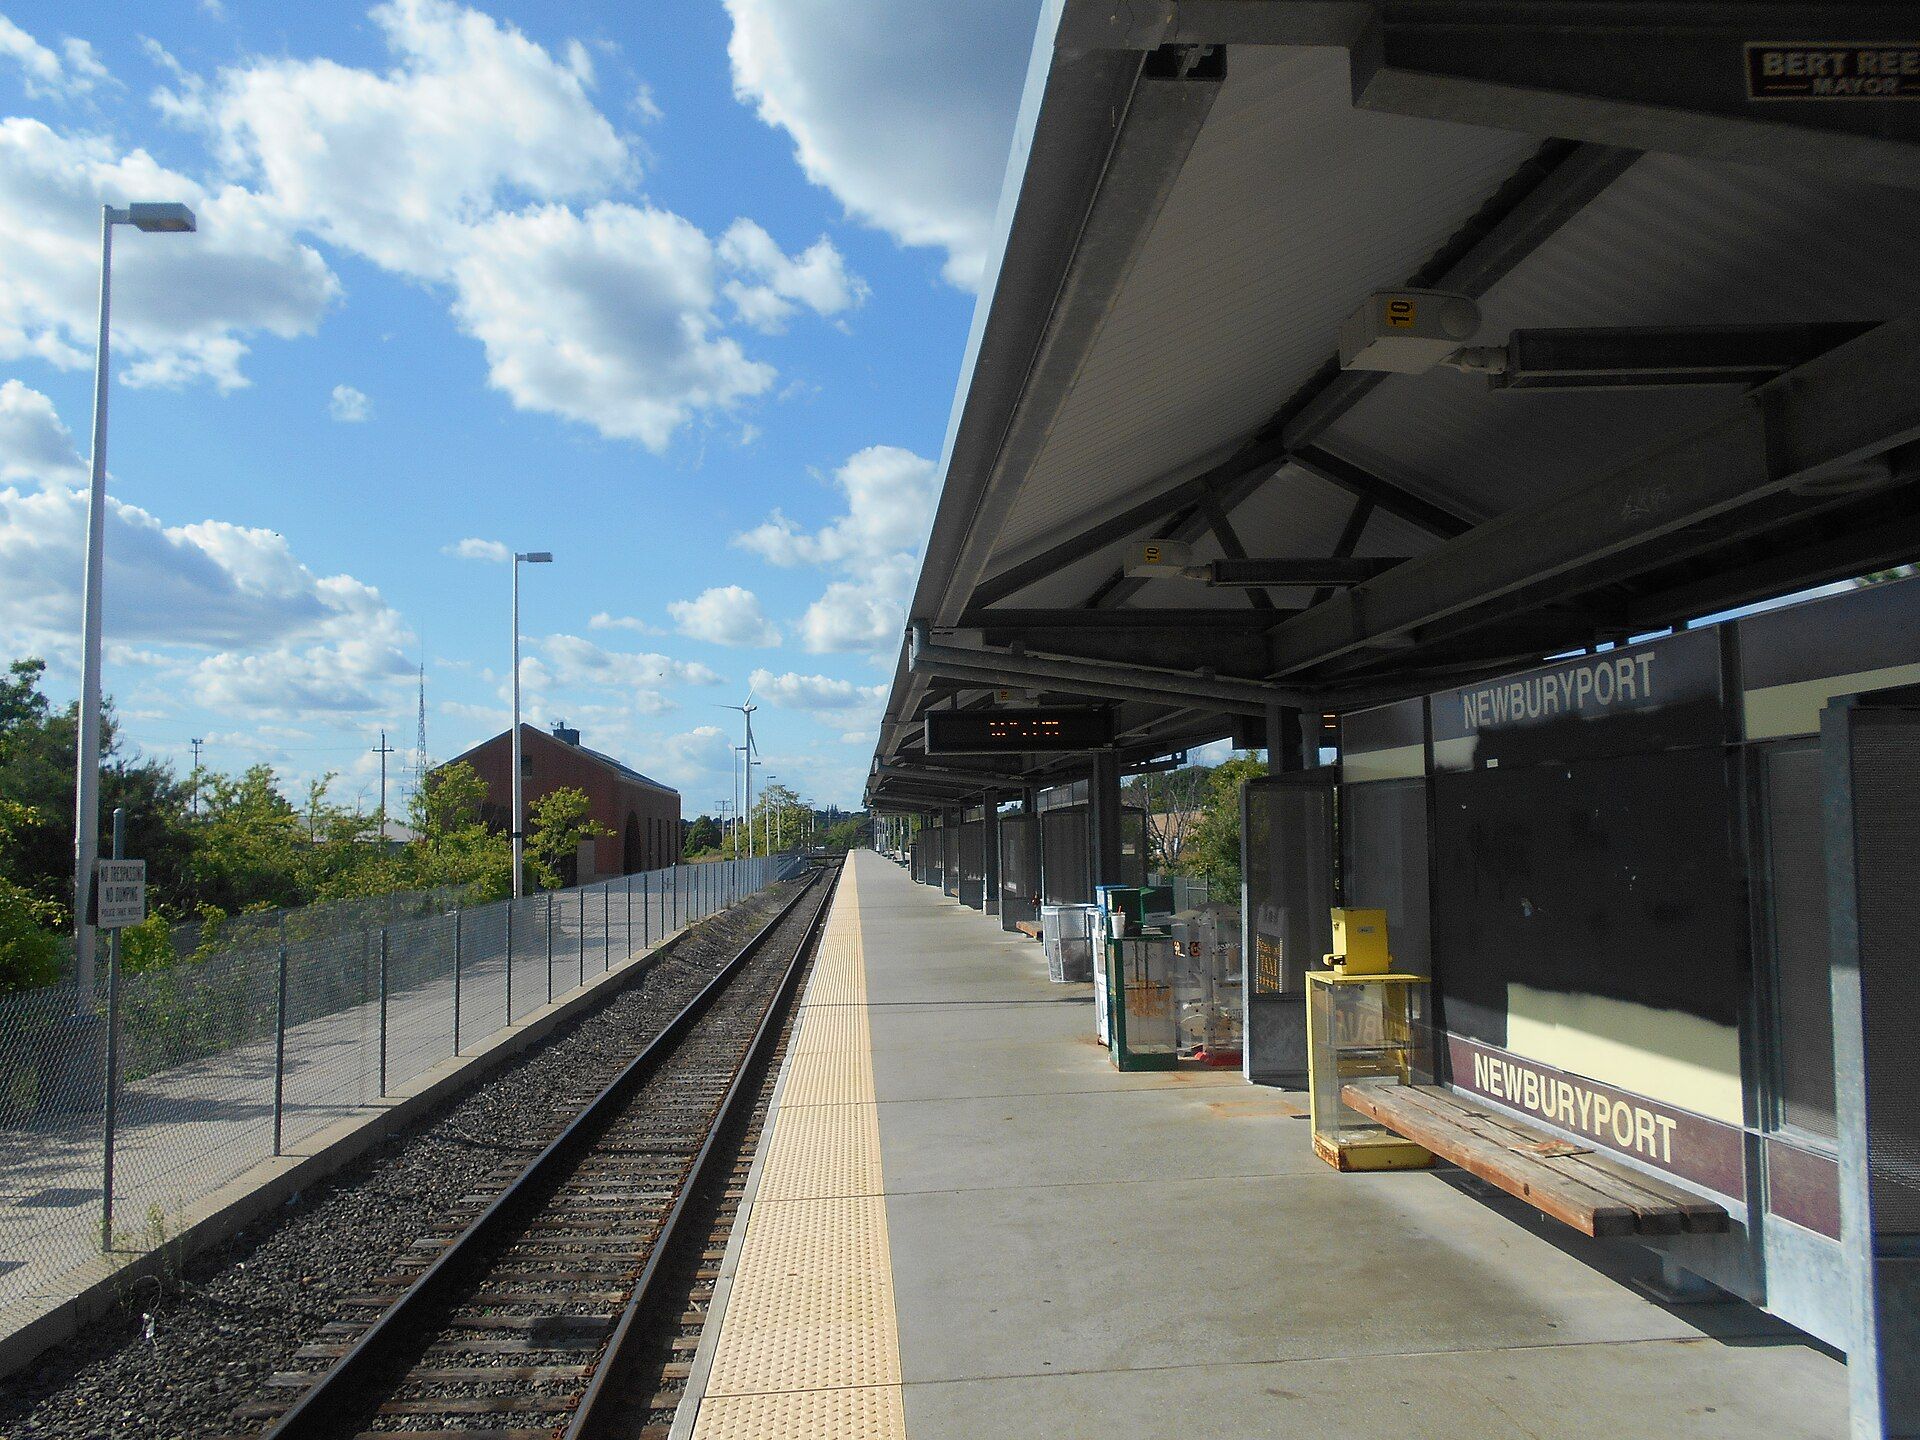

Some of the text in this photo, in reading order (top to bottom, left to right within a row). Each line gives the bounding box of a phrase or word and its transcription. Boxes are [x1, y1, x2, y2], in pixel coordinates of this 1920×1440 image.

[1762, 52, 1847, 76] BERT
[1813, 77, 1900, 95] MAYOR
[1391, 302, 1410, 324] 10
[1147, 548, 1158, 560] 10
[1463, 652, 1655, 729] NEWBURYPORT
[1473, 1051, 1678, 1164] NEWBURYPORT
